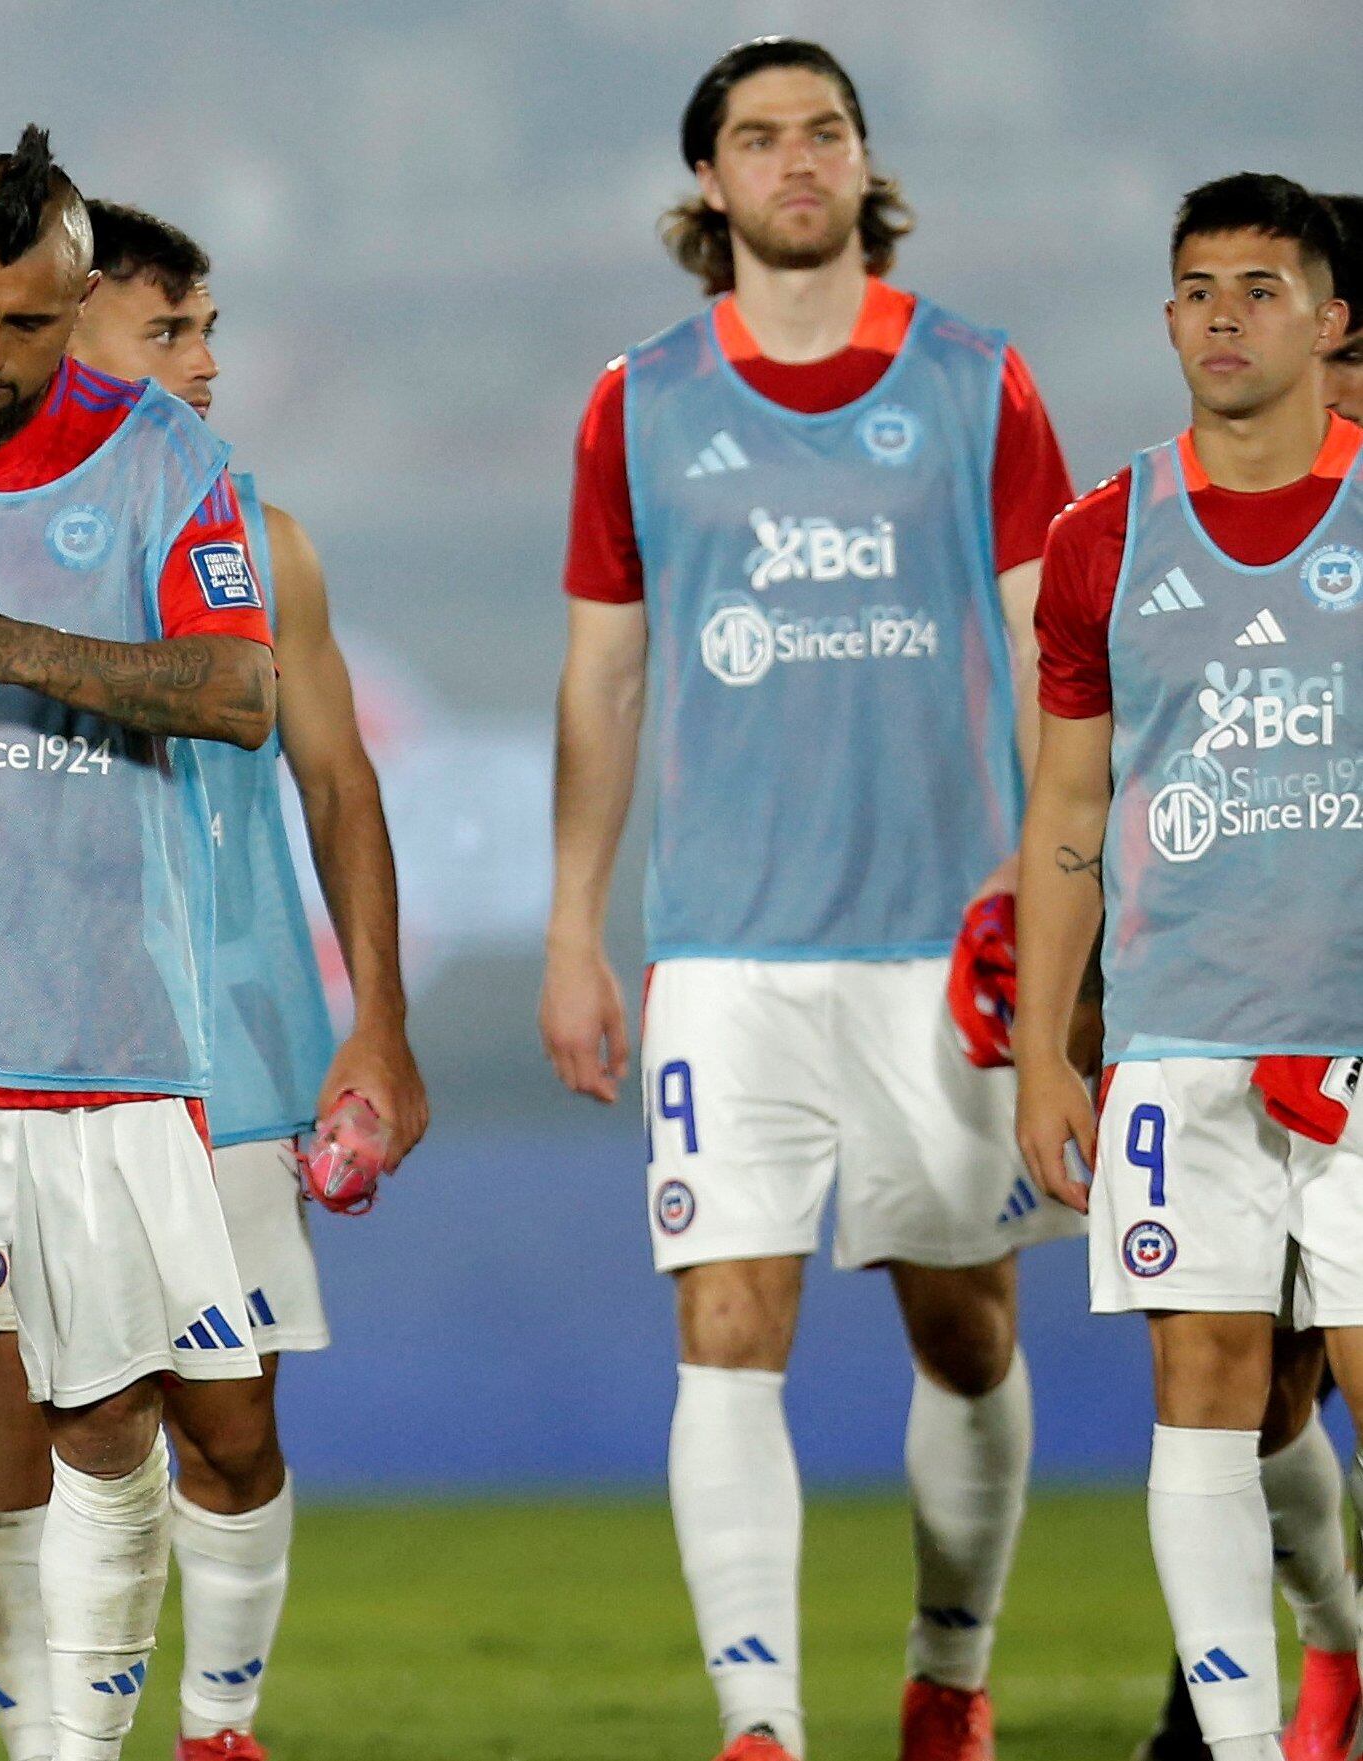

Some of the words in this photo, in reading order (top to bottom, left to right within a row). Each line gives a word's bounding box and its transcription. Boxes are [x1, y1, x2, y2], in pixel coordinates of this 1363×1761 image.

[810, 521, 896, 582] Bci
[706, 613, 768, 679] MG
[775, 624, 866, 662] Since
[871, 619, 938, 658] 1924
[1253, 691, 1334, 749] Bci
[37, 733, 113, 775] 1924
[1153, 788, 1212, 857] MG
[1220, 800, 1303, 838] Since
[1309, 792, 1363, 830] 192
[1125, 1103, 1166, 1206] 9
